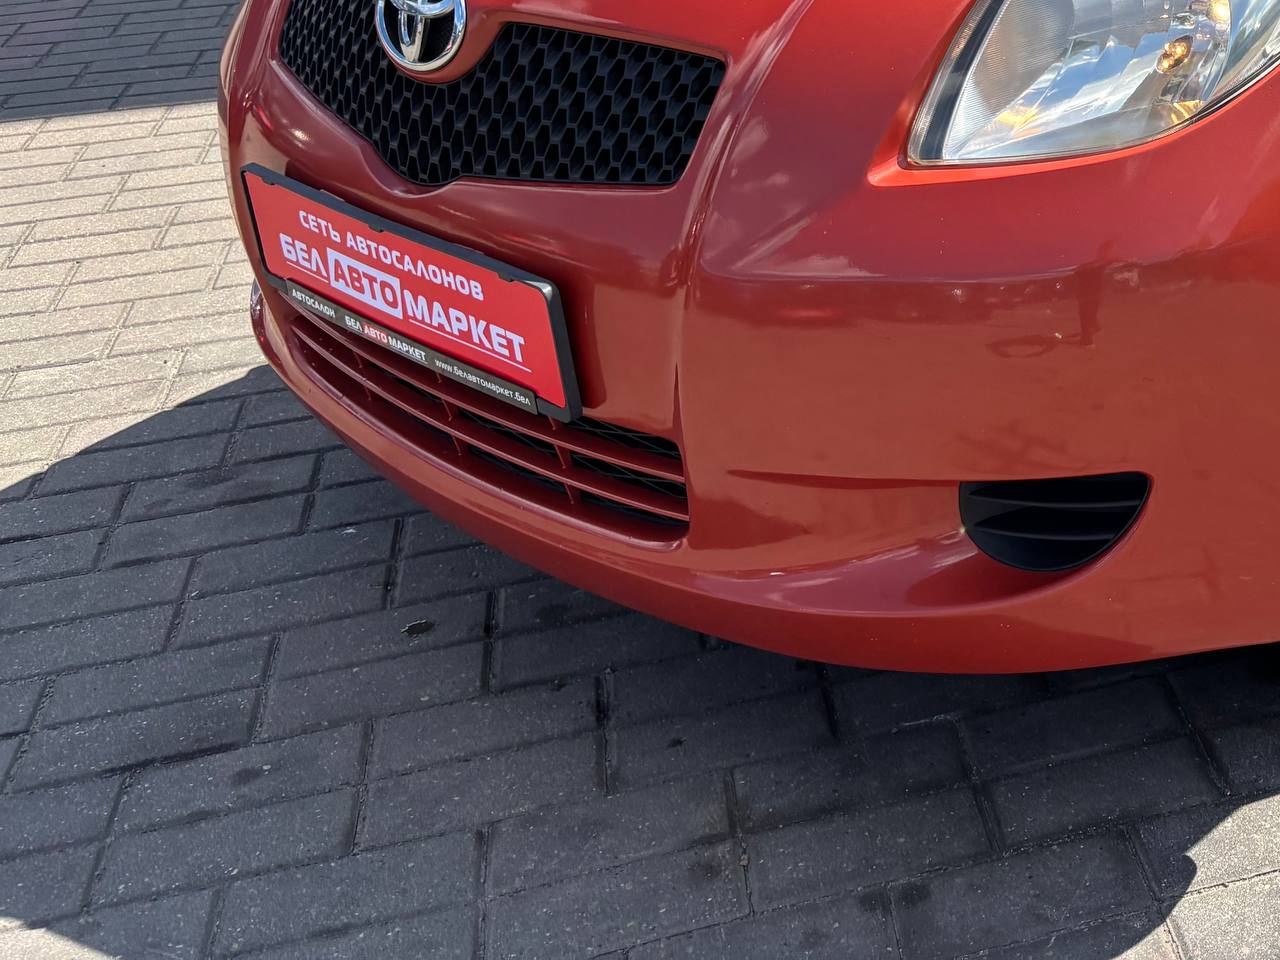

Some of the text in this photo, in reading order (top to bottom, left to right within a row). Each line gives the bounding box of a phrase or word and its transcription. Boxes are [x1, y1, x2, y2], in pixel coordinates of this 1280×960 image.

[299, 210, 484, 300] СЕТЬ АВТОСАЛОНОВ
[280, 233, 525, 362] БЕЛ АВТО МАРКЕТ
[292, 289, 336, 318] АВТОСАЛОН
[345, 315, 426, 361] БЕЛ АВТО МАРКЕТ
[434, 359, 531, 405] www.белавтомаркет.бел
